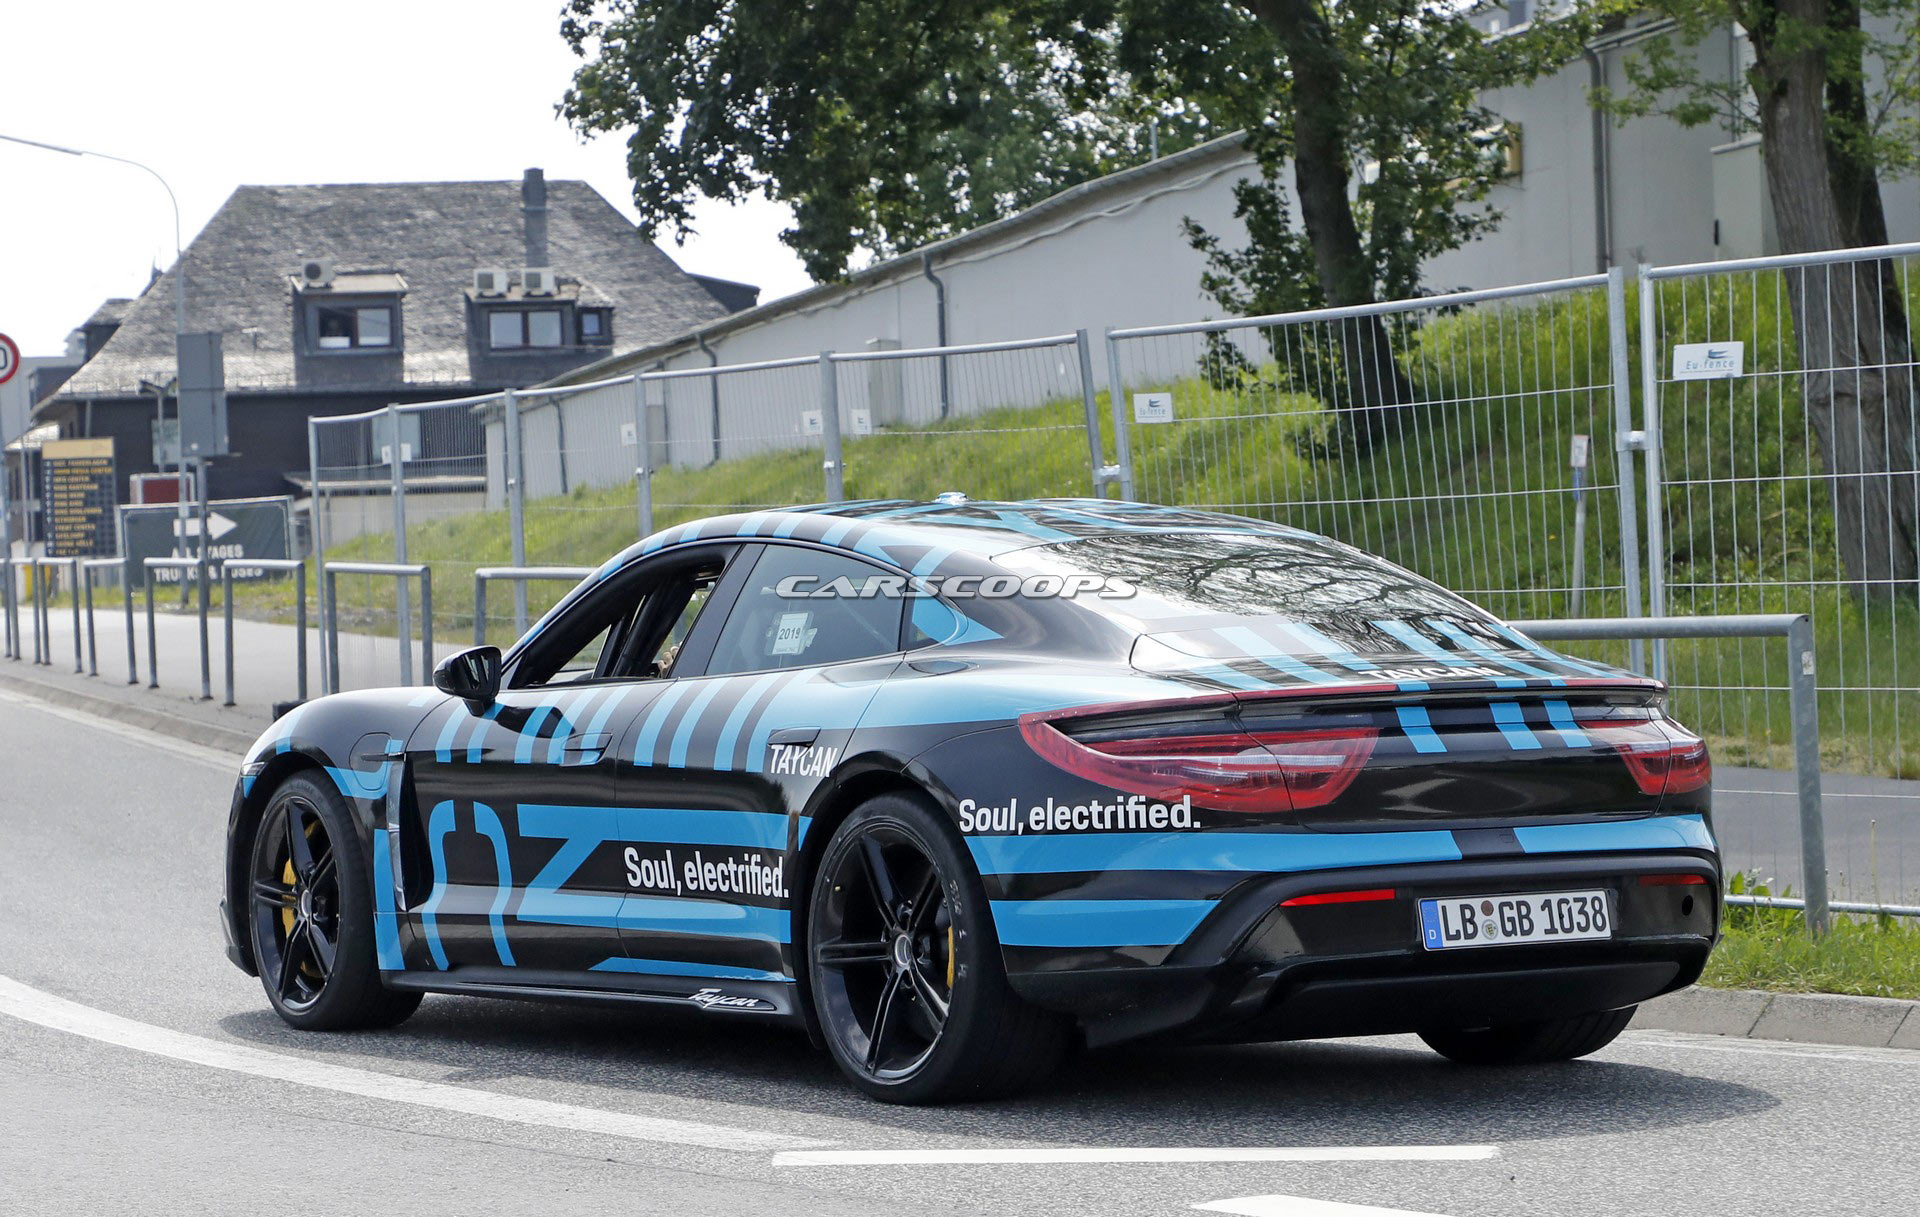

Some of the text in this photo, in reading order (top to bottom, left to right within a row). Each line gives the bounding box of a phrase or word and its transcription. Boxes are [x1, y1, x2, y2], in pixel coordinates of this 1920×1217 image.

[172, 547, 193, 558] AL
[154, 565, 199, 582] TRUK
[221, 566, 264, 578] USES
[778, 627, 801, 640] 2019
[1358, 667, 1506, 680] TAYCAN
[769, 744, 838, 778] TAYCAN
[959, 795, 1201, 835] Soul, electrified.
[624, 847, 789, 898] Soul, electrified.
[1429, 896, 1607, 941] D LB GB 1038
[688, 988, 759, 1008] Taycan
